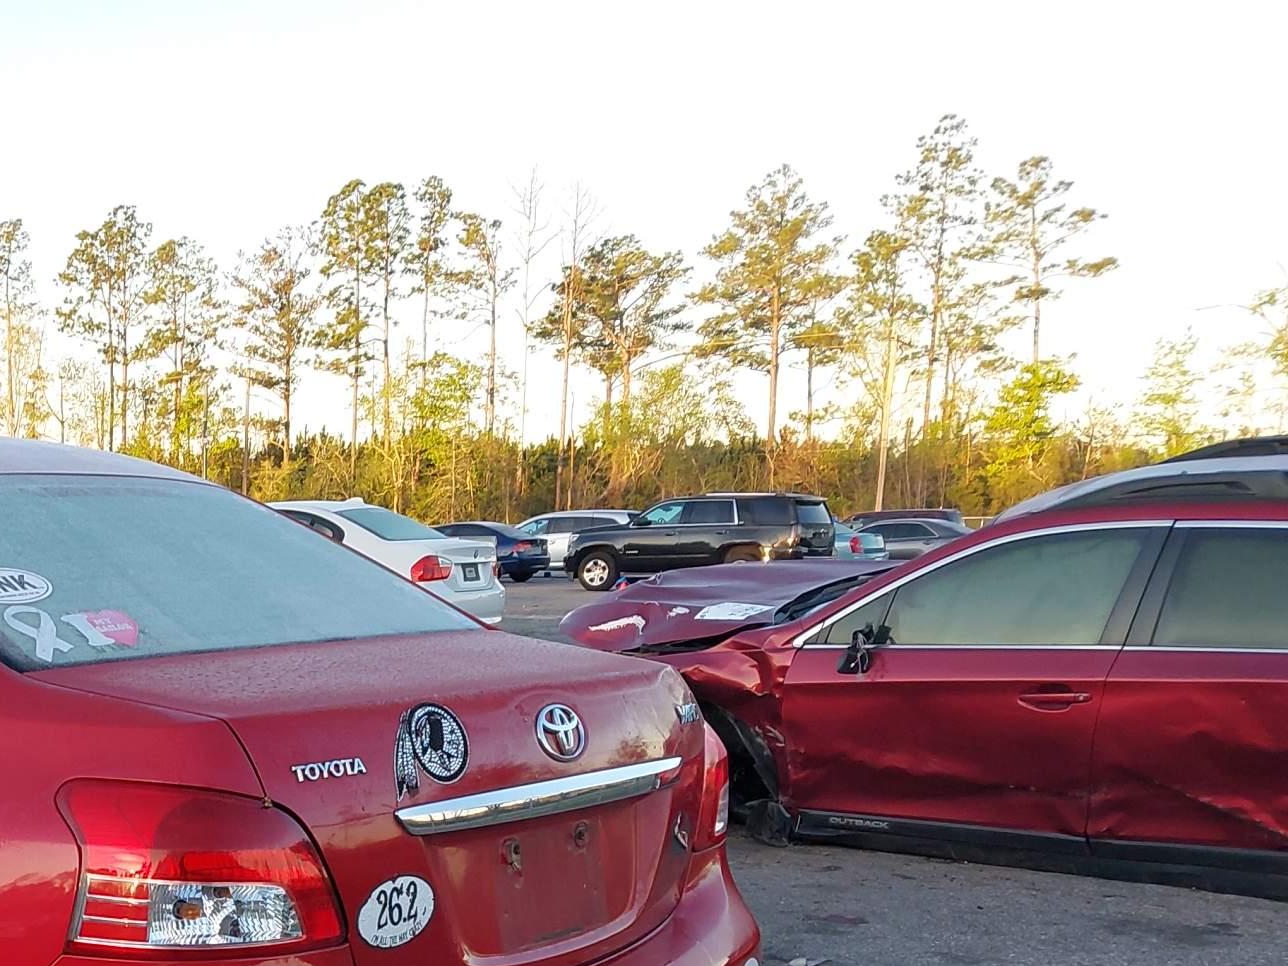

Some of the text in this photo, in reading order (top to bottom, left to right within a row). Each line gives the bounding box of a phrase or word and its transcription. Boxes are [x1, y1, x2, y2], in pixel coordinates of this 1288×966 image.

[291, 757, 367, 782] TOYOTA
[829, 816, 889, 829] OUTBACK
[376, 881, 418, 930] 26.2
